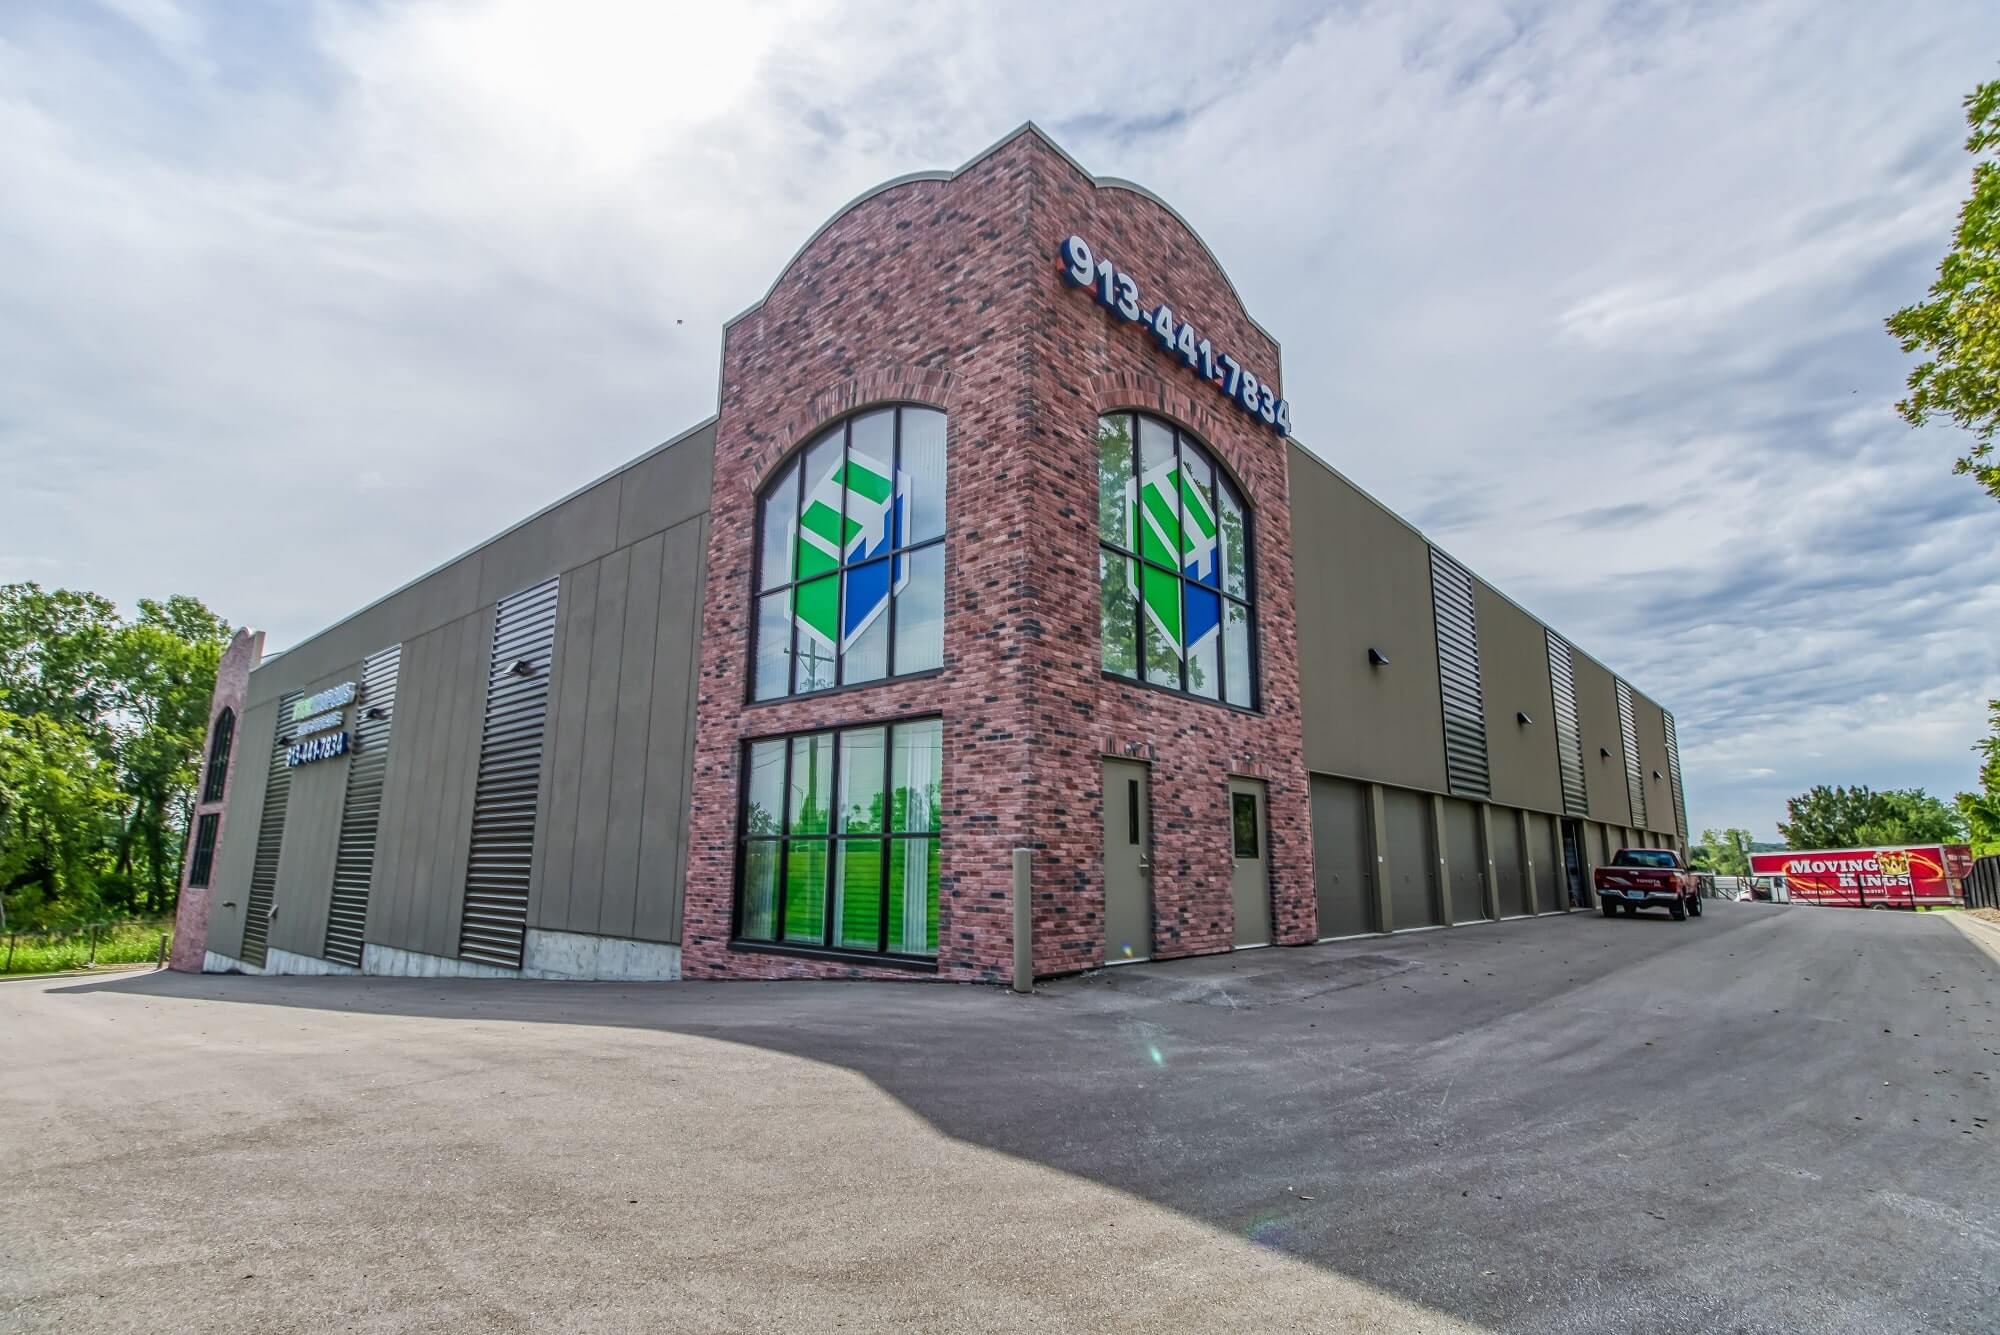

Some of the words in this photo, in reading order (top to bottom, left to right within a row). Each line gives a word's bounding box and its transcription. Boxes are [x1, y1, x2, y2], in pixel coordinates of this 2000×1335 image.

[1063, 235, 1291, 437] 913-441-7834
[1790, 858, 1880, 874] MOVING
[1836, 872, 1911, 887] KINGS
